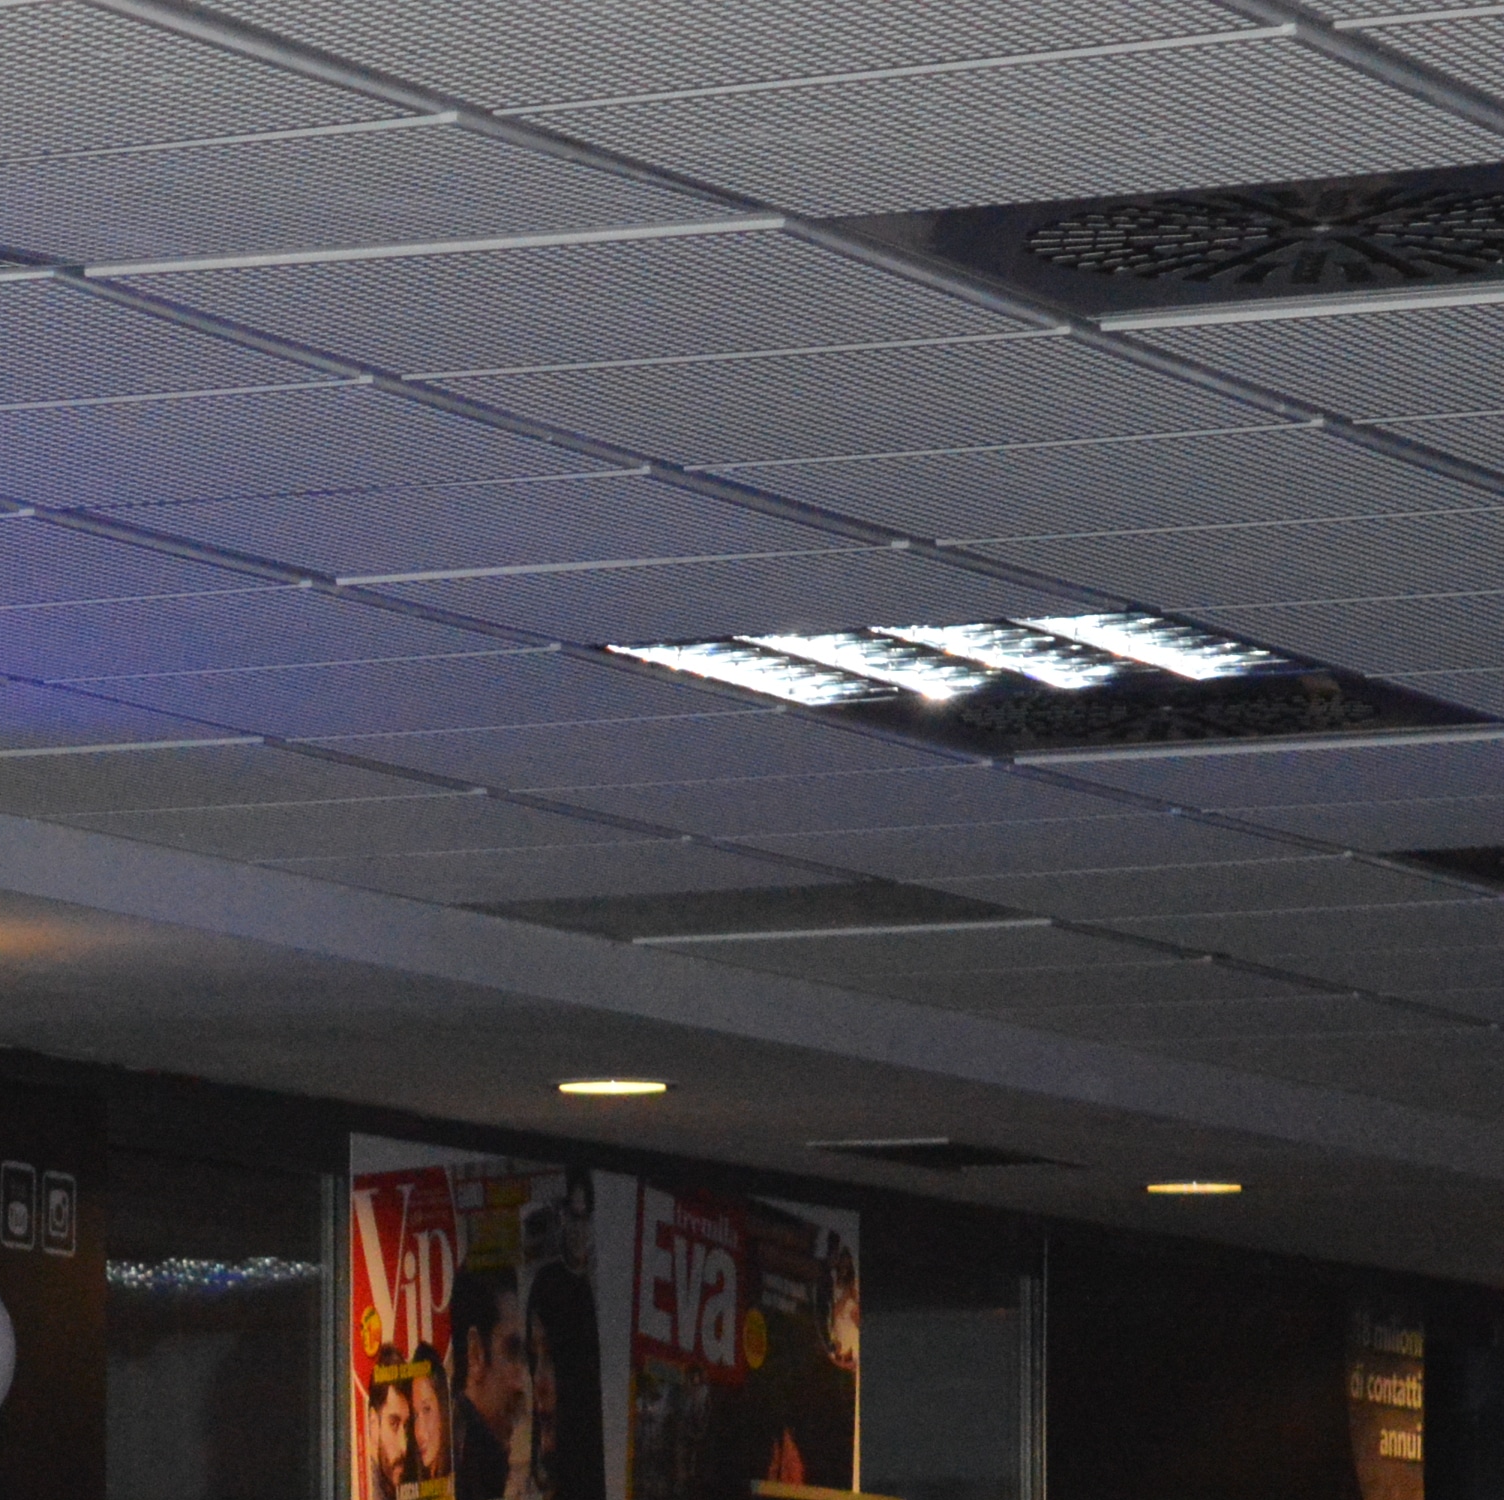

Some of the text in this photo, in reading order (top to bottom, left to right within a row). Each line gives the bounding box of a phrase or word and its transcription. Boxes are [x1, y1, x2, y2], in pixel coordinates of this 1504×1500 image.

[352, 1183, 456, 1363] Vip
[638, 1185, 737, 1367] Eva
[1367, 1369, 1424, 1410] contatti
[1379, 1422, 1424, 1462] annui
